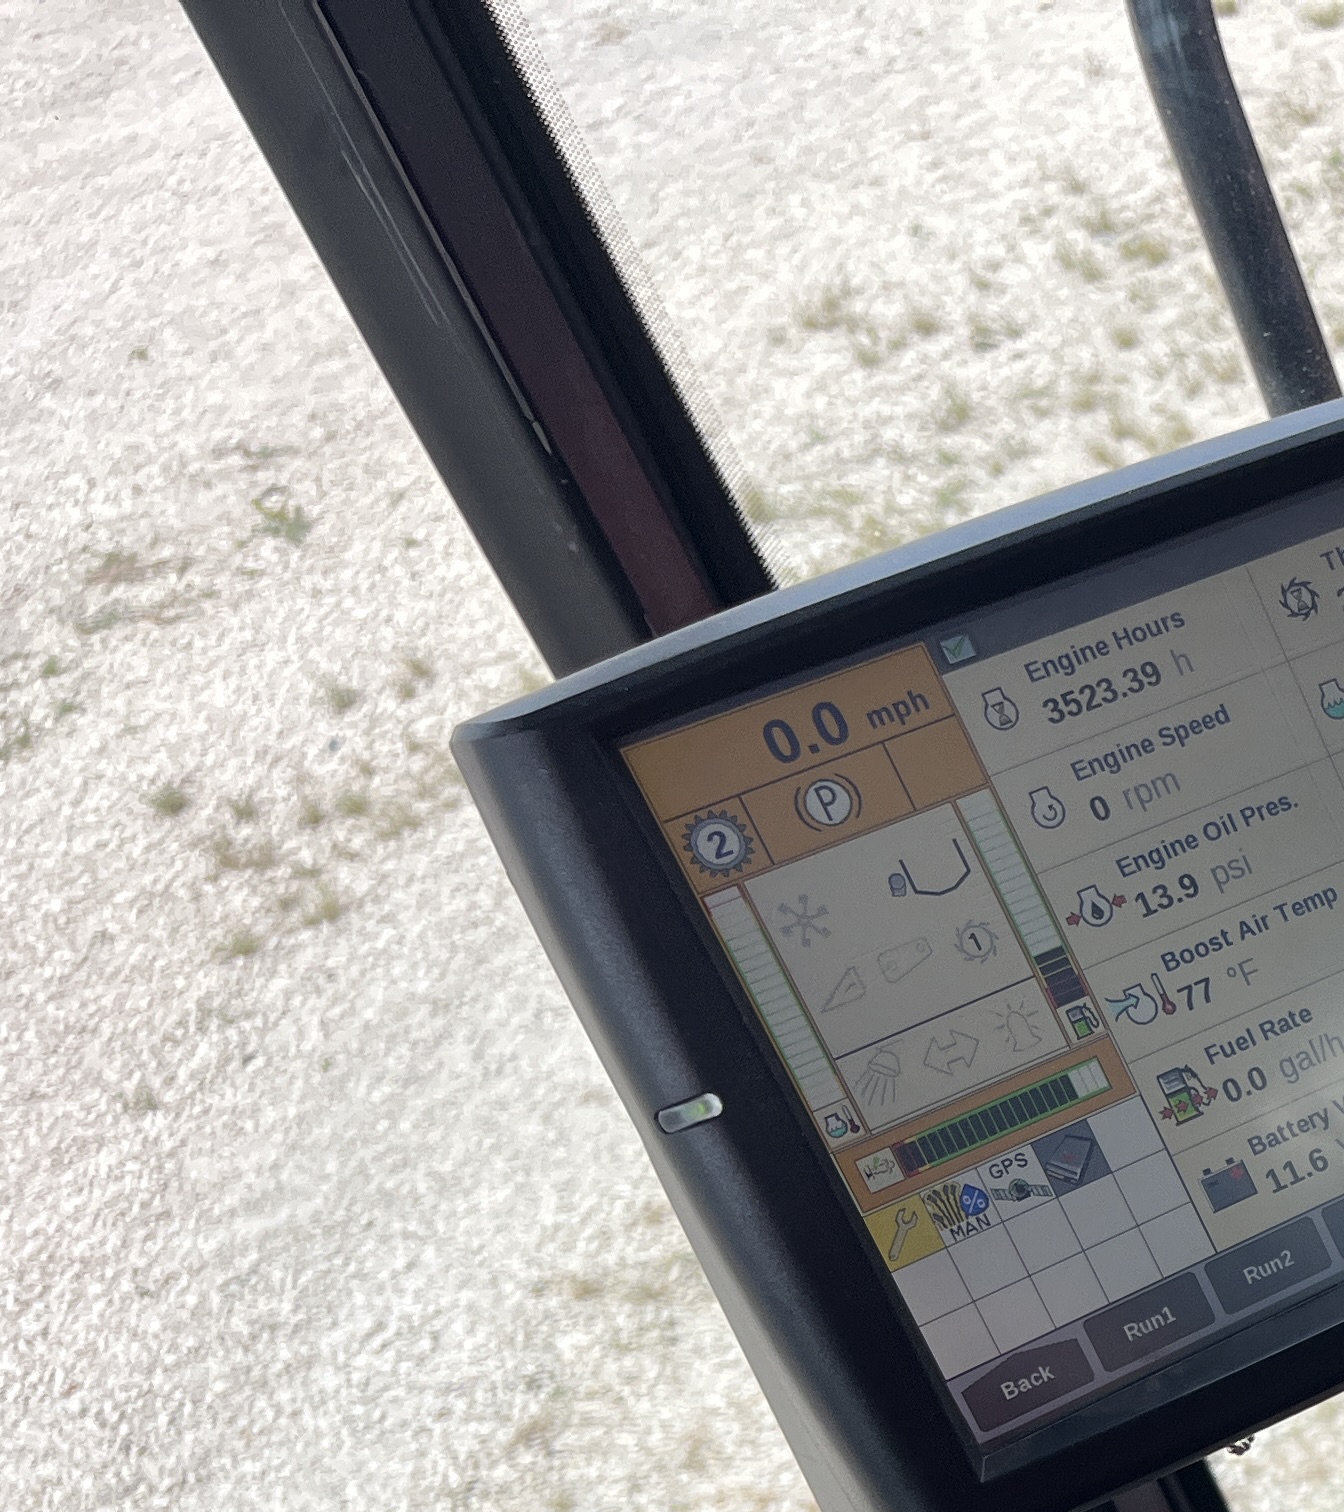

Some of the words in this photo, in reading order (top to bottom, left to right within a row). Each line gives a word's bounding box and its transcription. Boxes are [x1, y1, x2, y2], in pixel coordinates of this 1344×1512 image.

[1023, 639, 1111, 683] Engine
[1112, 611, 1186, 651] Hours
[1042, 660, 1162, 725] 3523.39
[1169, 649, 1195, 677] h
[762, 701, 849, 764] 0.0
[866, 689, 930, 730] mph
[1070, 738, 1156, 781] Engine
[1158, 703, 1231, 748] Speed
[1089, 795, 1112, 821] 0
[1122, 771, 1182, 812] rpm
[1115, 833, 1199, 878] Engine
[1202, 814, 1239, 843] Oil
[1239, 794, 1300, 828] Pres.
[1134, 873, 1201, 919] 13.9
[1209, 848, 1254, 893] psi
[1160, 929, 1233, 973] Boost
[1238, 913, 1270, 942] Air
[1273, 887, 1338, 923] Temp
[1176, 977, 1212, 1011] 77
[1204, 1028, 1256, 1066] Fuel
[1258, 1007, 1313, 1041] Rate
[1222, 1065, 1268, 1102] 0.0
[1247, 1106, 1331, 1156] Battery
[988, 1152, 1029, 1181] GPS
[1264, 1148, 1330, 1194] 11.6
[950, 1215, 992, 1243] MAN
[1242, 1249, 1295, 1286] Run2
[1123, 1306, 1178, 1343] Run1
[1000, 1364, 1056, 1401] Back
